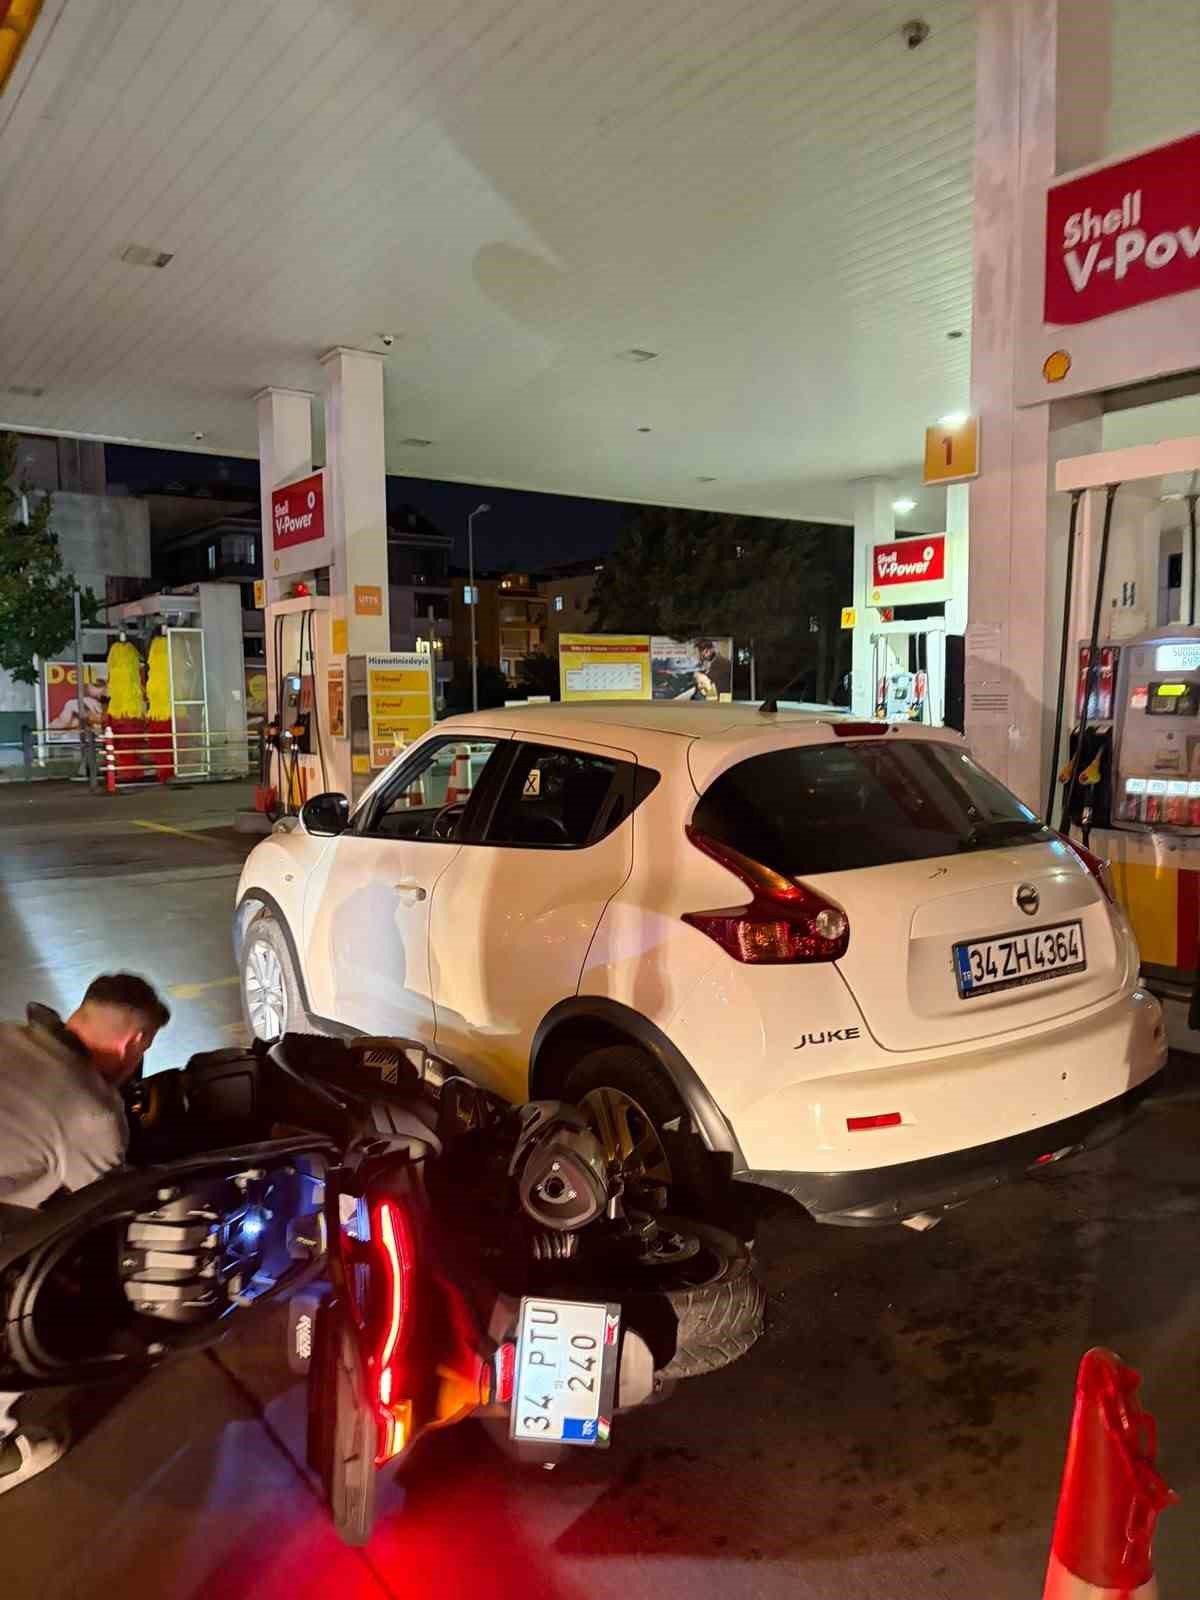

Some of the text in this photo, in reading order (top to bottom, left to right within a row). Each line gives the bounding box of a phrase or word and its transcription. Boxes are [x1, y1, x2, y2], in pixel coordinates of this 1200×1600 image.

[1062, 189, 1142, 249] Shell
[942, 436, 952, 466] 1
[274, 500, 289, 518] Shell
[275, 513, 313, 537] V-Power
[877, 551, 898, 563] Shell
[877, 559, 930, 579] V-Power
[845, 612, 852, 625] 7
[970, 928, 1080, 982] 34 ZH 4364
[793, 1027, 861, 1050] JUKE
[523, 1307, 559, 1431] 34 PTU
[567, 1335, 598, 1393] 240
